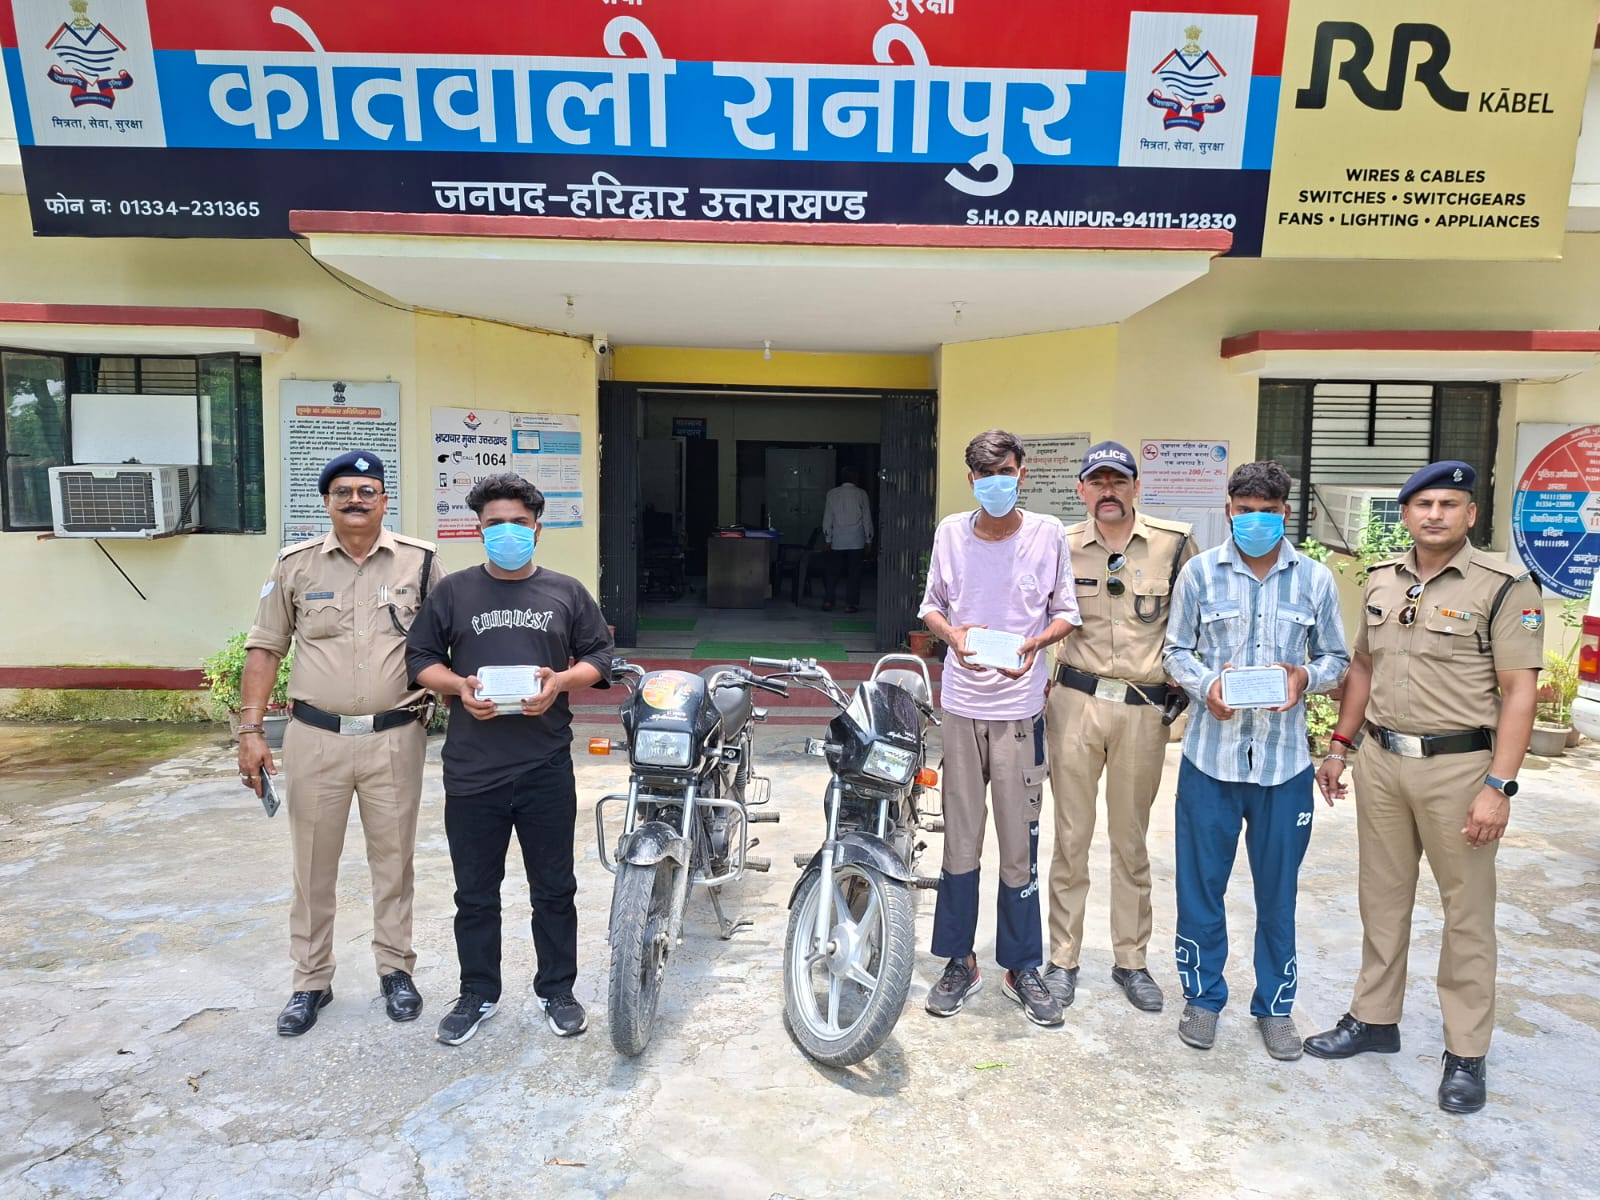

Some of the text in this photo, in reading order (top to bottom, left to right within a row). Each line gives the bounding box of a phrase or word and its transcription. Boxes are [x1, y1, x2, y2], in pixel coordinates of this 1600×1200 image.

[1295, 20, 1470, 112] RR
[195, 5, 1087, 197] कोतवाली रानीपुर
[115, 119, 143, 132] सुरक्षा
[1199, 142, 1225, 155] सुरक्षा
[1346, 168, 1486, 183] WIRES & CABLES
[44, 192, 84, 215] फोन
[119, 200, 260, 217] 01334-231365
[699, 187, 868, 220] उत्तराखण्ड
[1298, 190, 1526, 206] SWITCHES SWITCHGEARS
[966, 209, 1237, 230] S.H.O RANIPUR-94111-12830
[1278, 212, 1541, 228] FANS LIGHTING APPLIANCES
[474, 452, 506, 466] 1064
[1088, 449, 1127, 463] POLICE
[1296, 812, 1312, 827] 23
